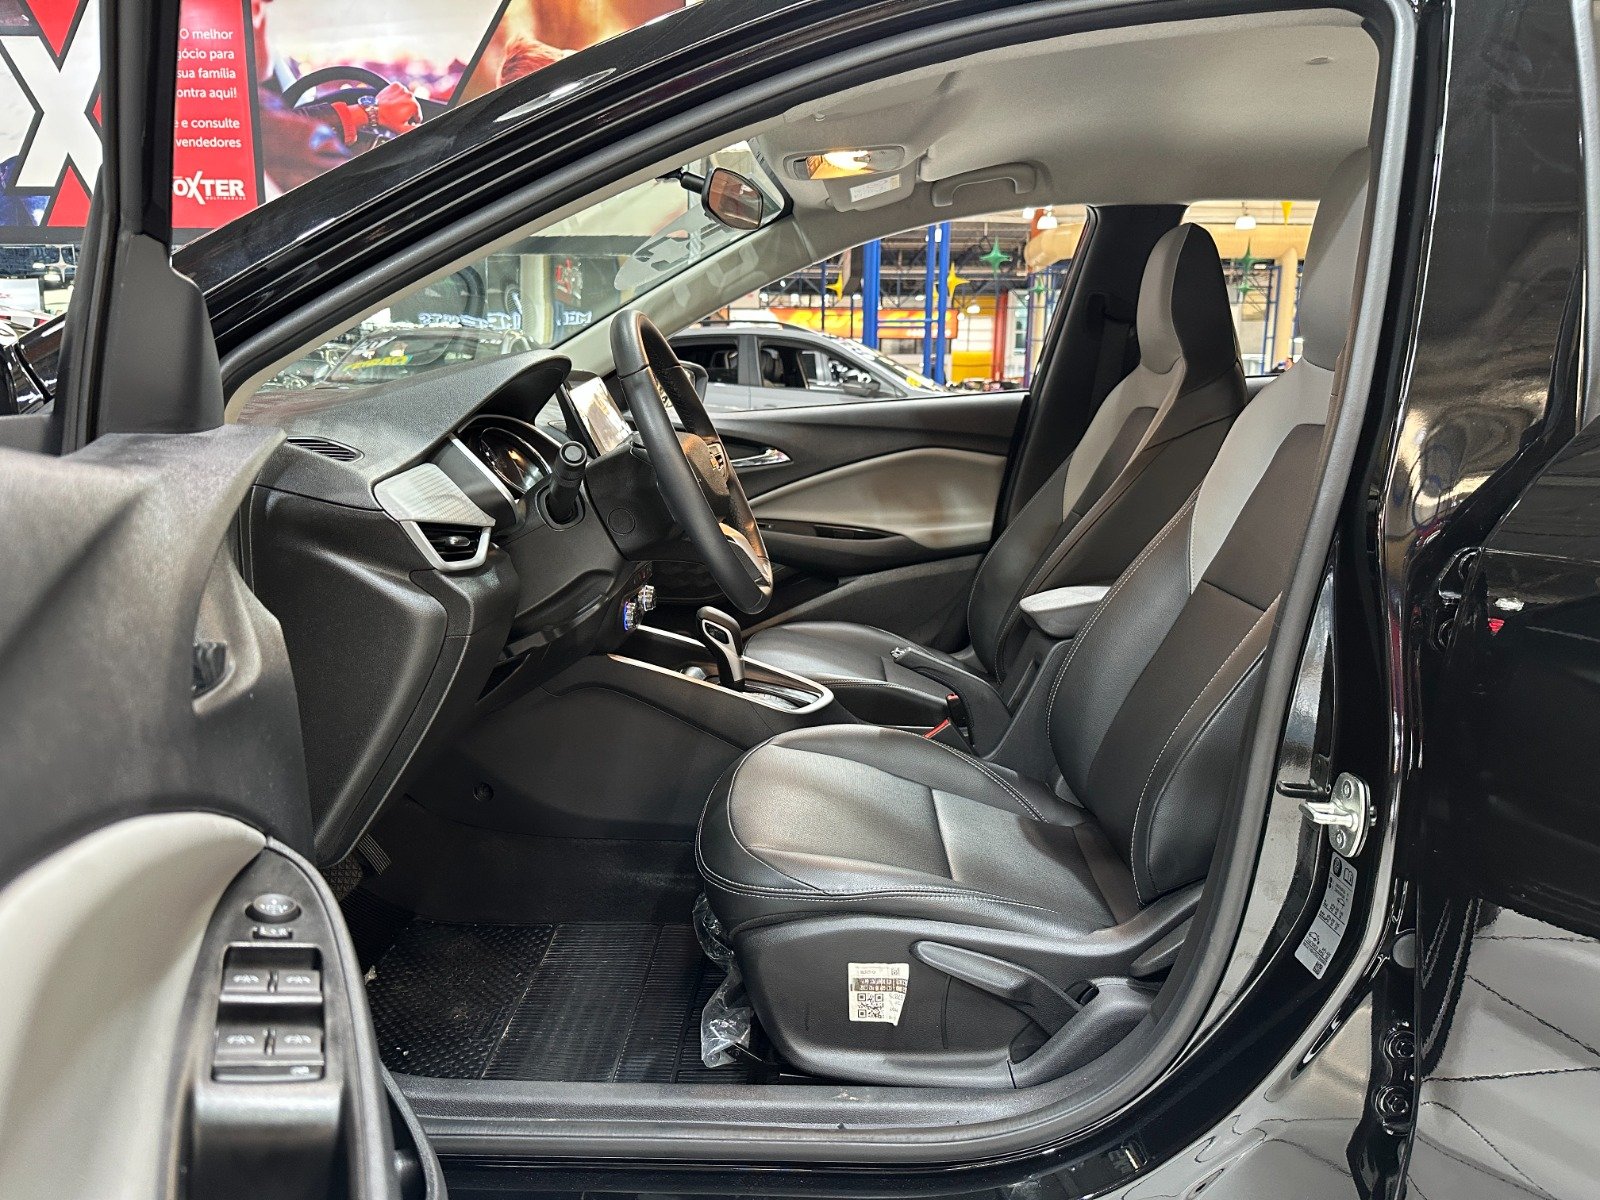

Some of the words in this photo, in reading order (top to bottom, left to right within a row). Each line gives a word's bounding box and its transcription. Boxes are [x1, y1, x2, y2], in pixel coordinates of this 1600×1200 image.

[180, 28, 189, 40] O
[192, 28, 233, 40] melhor
[177, 48, 206, 61] ócio
[209, 50, 234, 61] para
[177, 69, 195, 79] sua
[198, 67, 236, 79] família
[177, 87, 206, 98] ontra
[209, 87, 237, 100] aqui!
[181, 119, 188, 128] e
[191, 117, 240, 129] consulte
[175, 137, 242, 148] vendedores
[173, 170, 245, 205] OXTER
